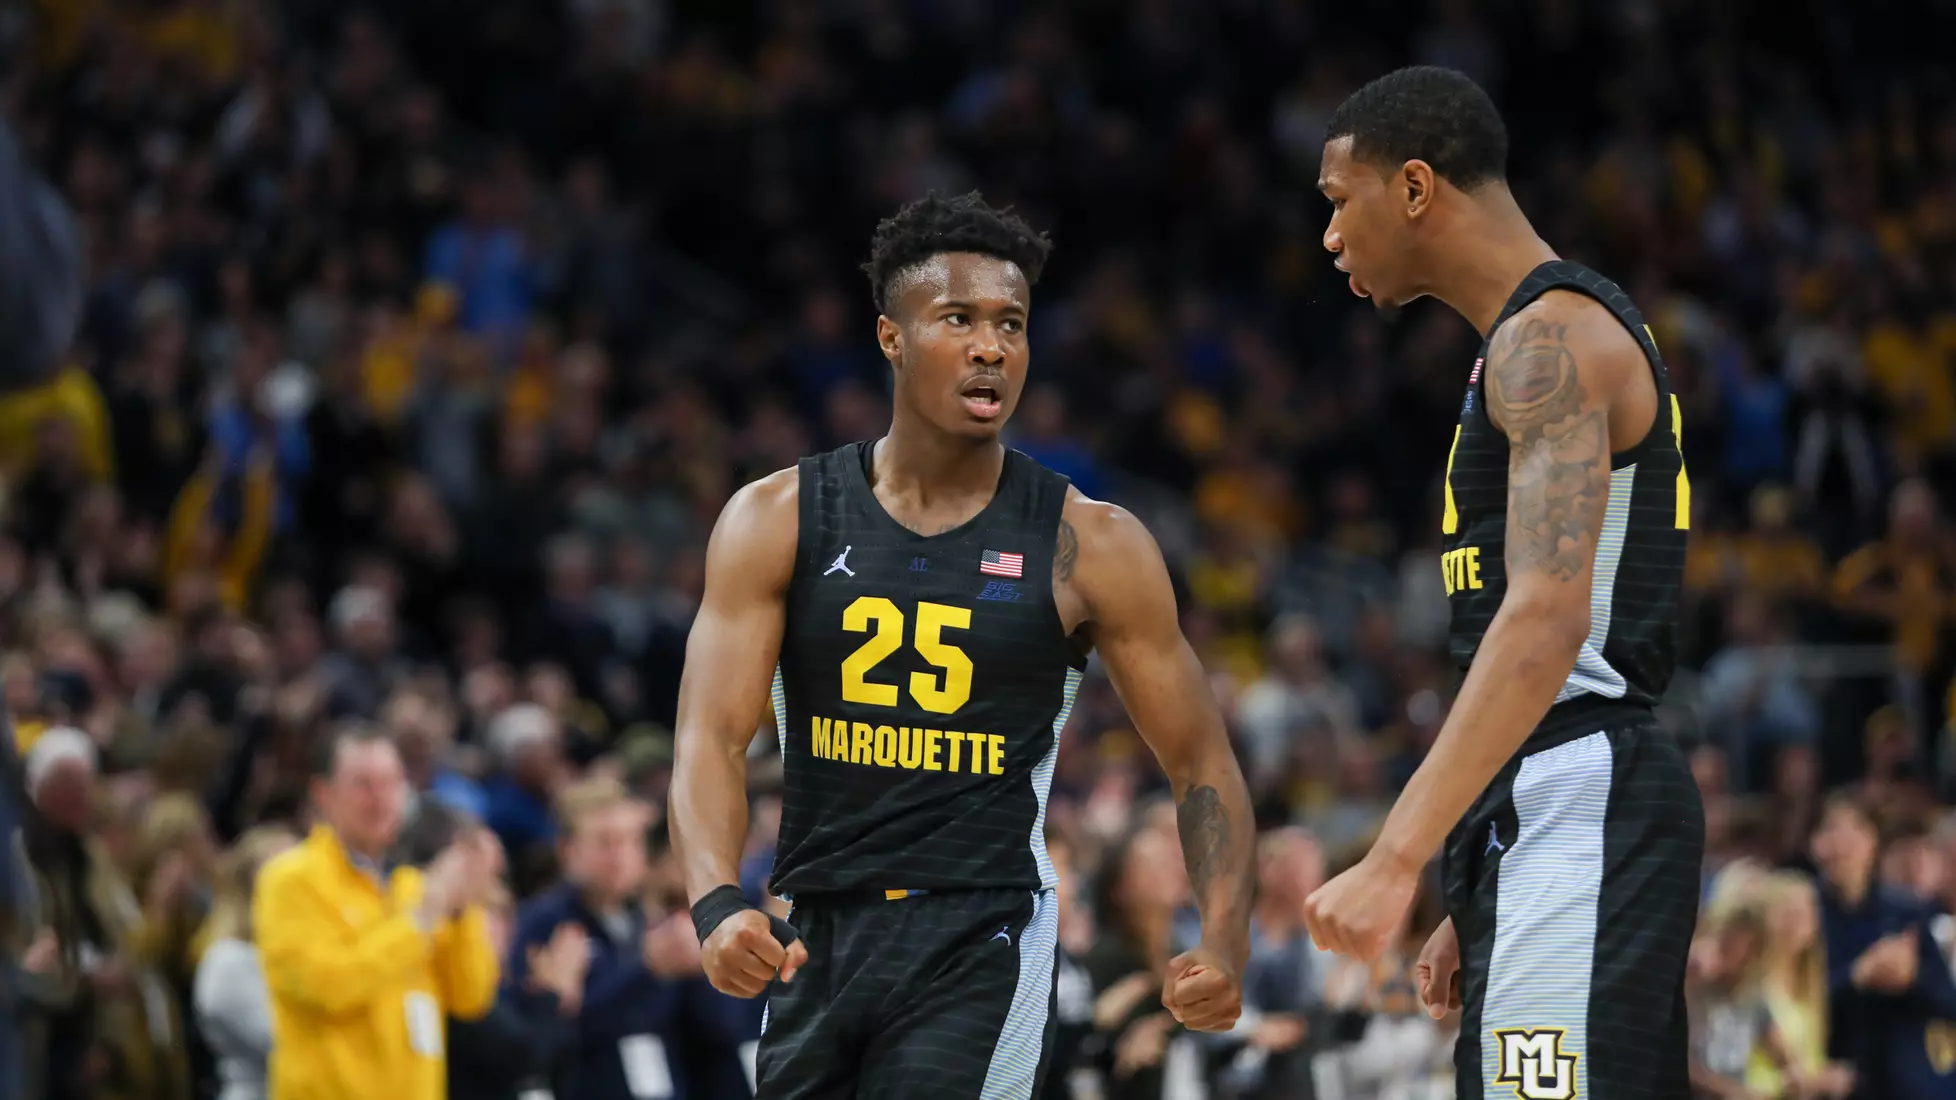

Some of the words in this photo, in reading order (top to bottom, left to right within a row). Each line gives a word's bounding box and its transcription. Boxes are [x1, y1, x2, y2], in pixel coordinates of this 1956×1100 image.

[979, 589, 1024, 600] EAST
[985, 581, 1016, 591] BIG
[841, 596, 974, 715] 25
[811, 716, 1005, 776] MARQUETTE
[1495, 1029, 1578, 1100] MU
